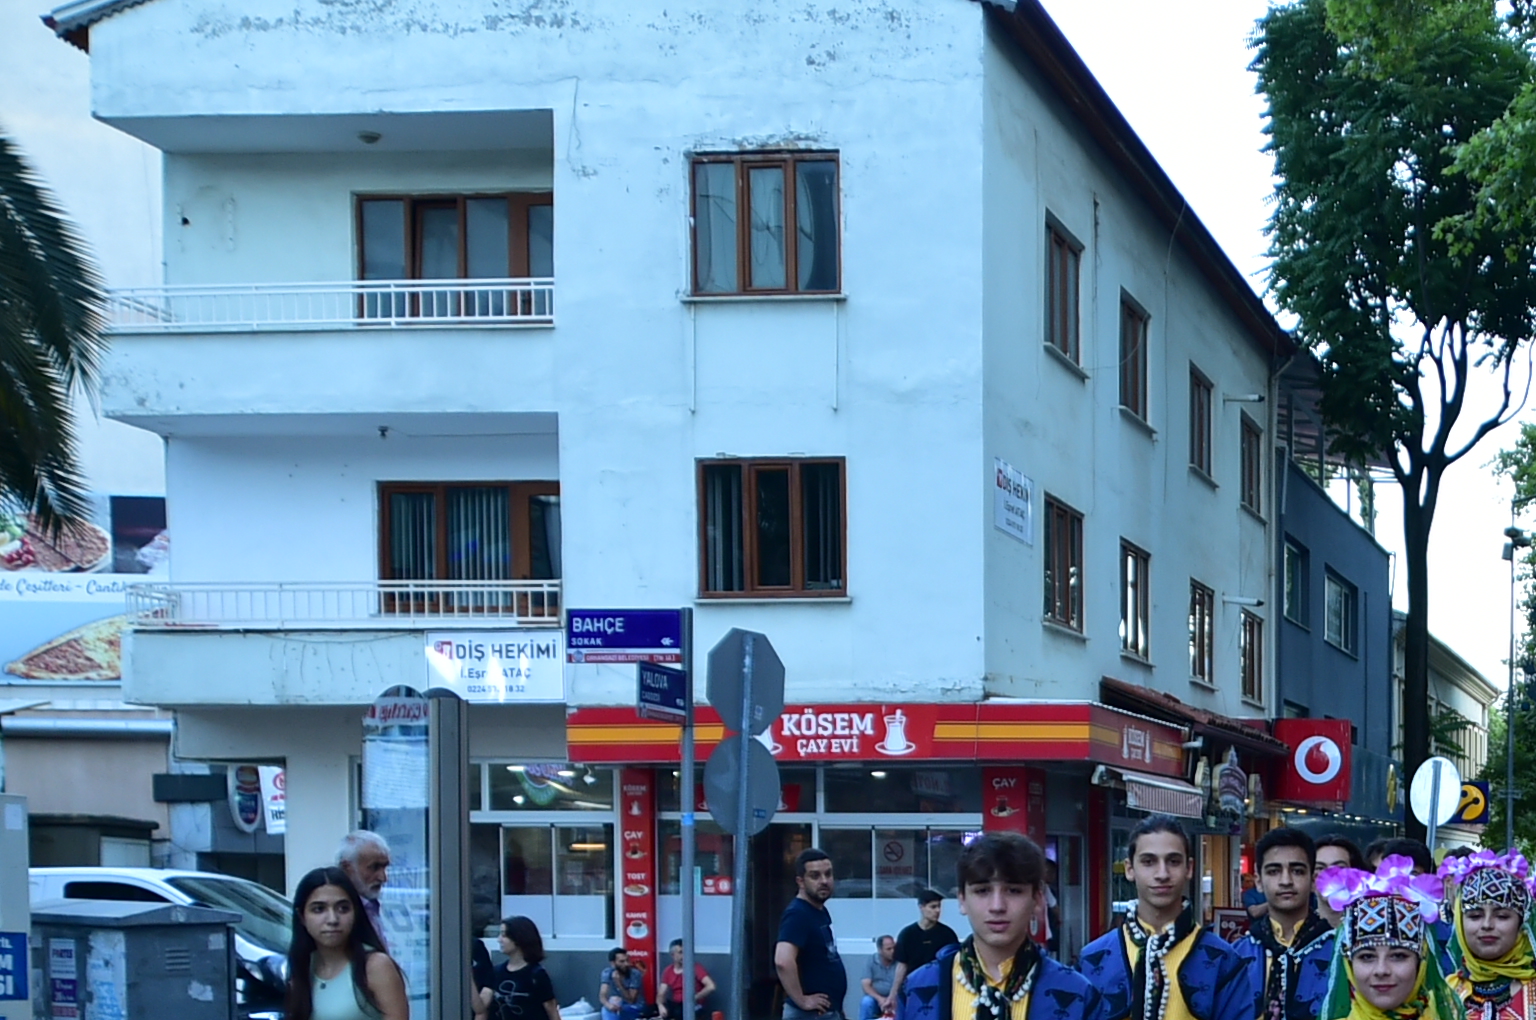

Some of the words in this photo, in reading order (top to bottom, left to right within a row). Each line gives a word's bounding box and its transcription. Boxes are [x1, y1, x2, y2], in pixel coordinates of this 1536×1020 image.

[572, 617, 625, 635] BAHÇE
[571, 637, 603, 646] SOKAK
[455, 639, 486, 662] DİŞ
[491, 639, 557, 659] HEKİMİ
[641, 670, 669, 690] YALOVA
[797, 739, 828, 757] ÇAY
[830, 736, 859, 753] EVİ
[992, 778, 1017, 789] ÇAY
[624, 831, 644, 840] ÇAY
[626, 872, 646, 880] TOST
